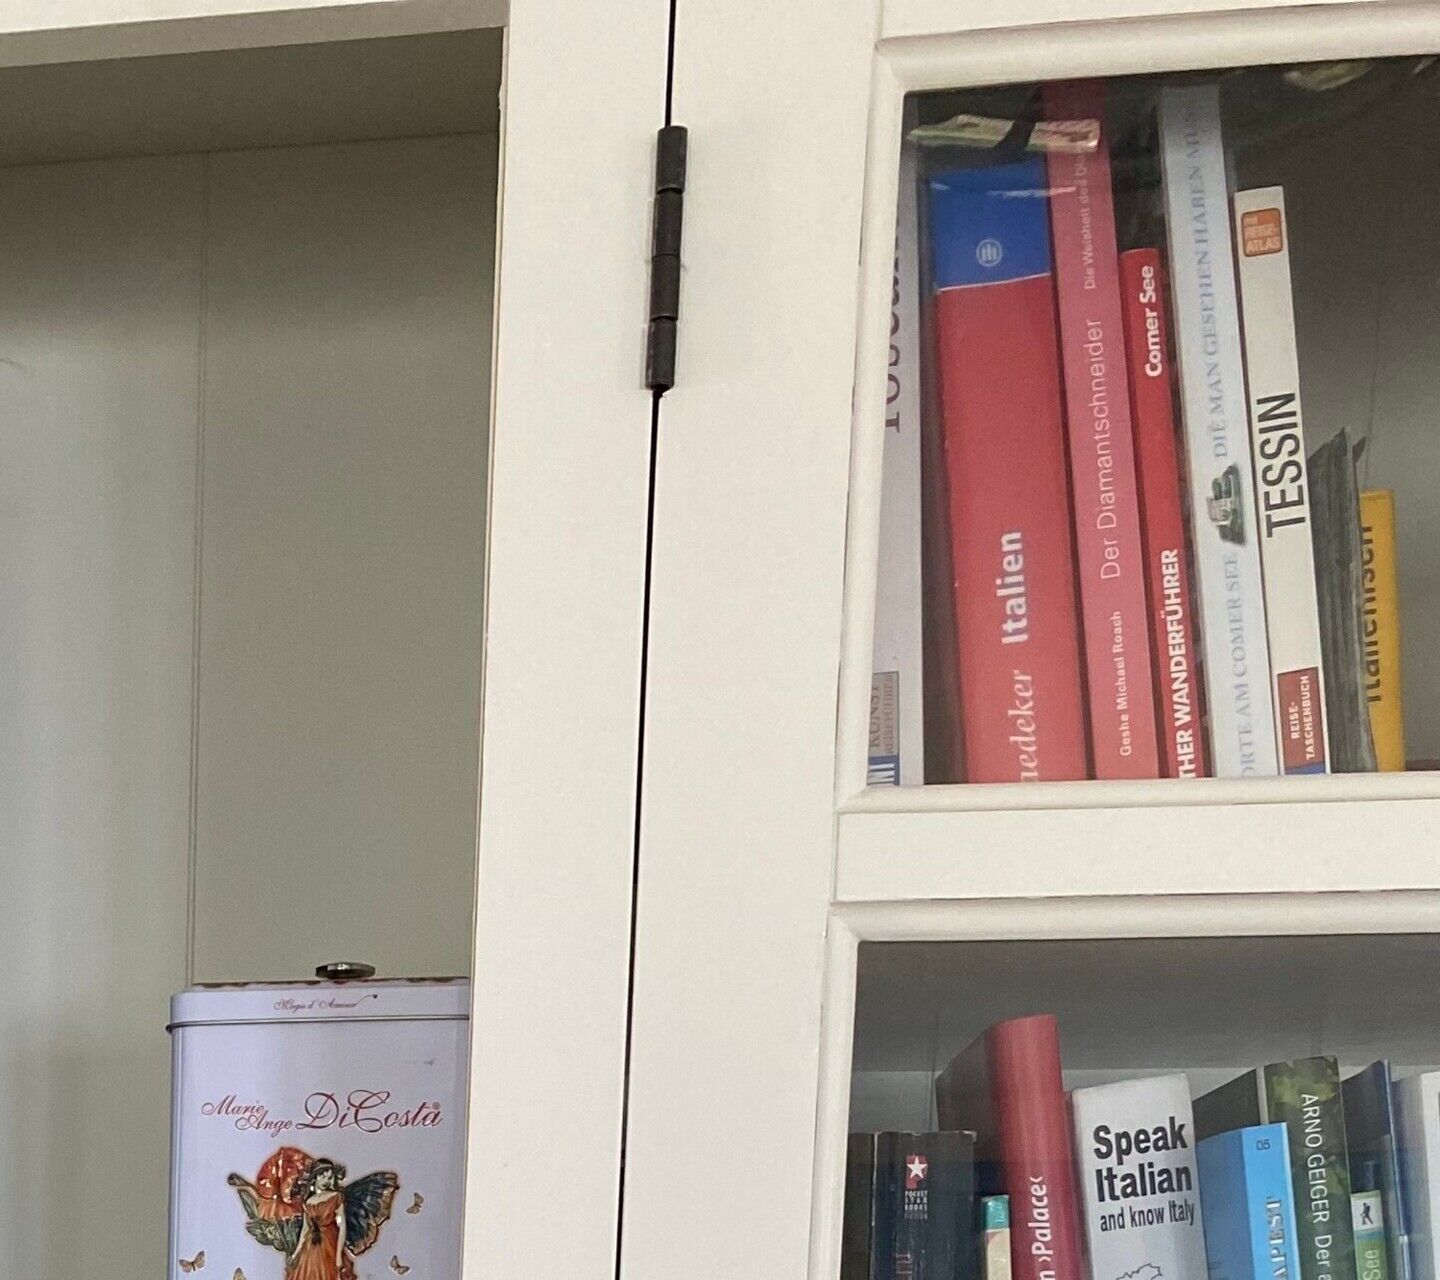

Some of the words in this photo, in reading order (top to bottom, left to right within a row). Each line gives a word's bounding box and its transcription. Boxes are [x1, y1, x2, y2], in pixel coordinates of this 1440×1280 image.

[1138, 264, 1156, 305] See
[1144, 308, 1162, 377] Comer
[1087, 318, 1117, 530] Diamantschneider
[1256, 391, 1307, 538] TESSIN
[1100, 536, 1121, 580] Der
[996, 531, 1029, 645] Italien
[1113, 610, 1124, 654] Roach
[1159, 548, 1192, 725] WANDERFÜHRER
[1116, 656, 1129, 710] Michael
[201, 1093, 265, 1117] Marie
[235, 1109, 294, 1137] Ange
[1301, 1093, 1323, 1149] ARNO
[1092, 1115, 1188, 1165] Speak
[1095, 1162, 1193, 1203] Italian
[1307, 1153, 1331, 1225] GEIGER
[1099, 1211, 1127, 1232] and
[1128, 1205, 1165, 1229] know
[1167, 1198, 1196, 1228] Italy
[1314, 1234, 1333, 1267] Der
